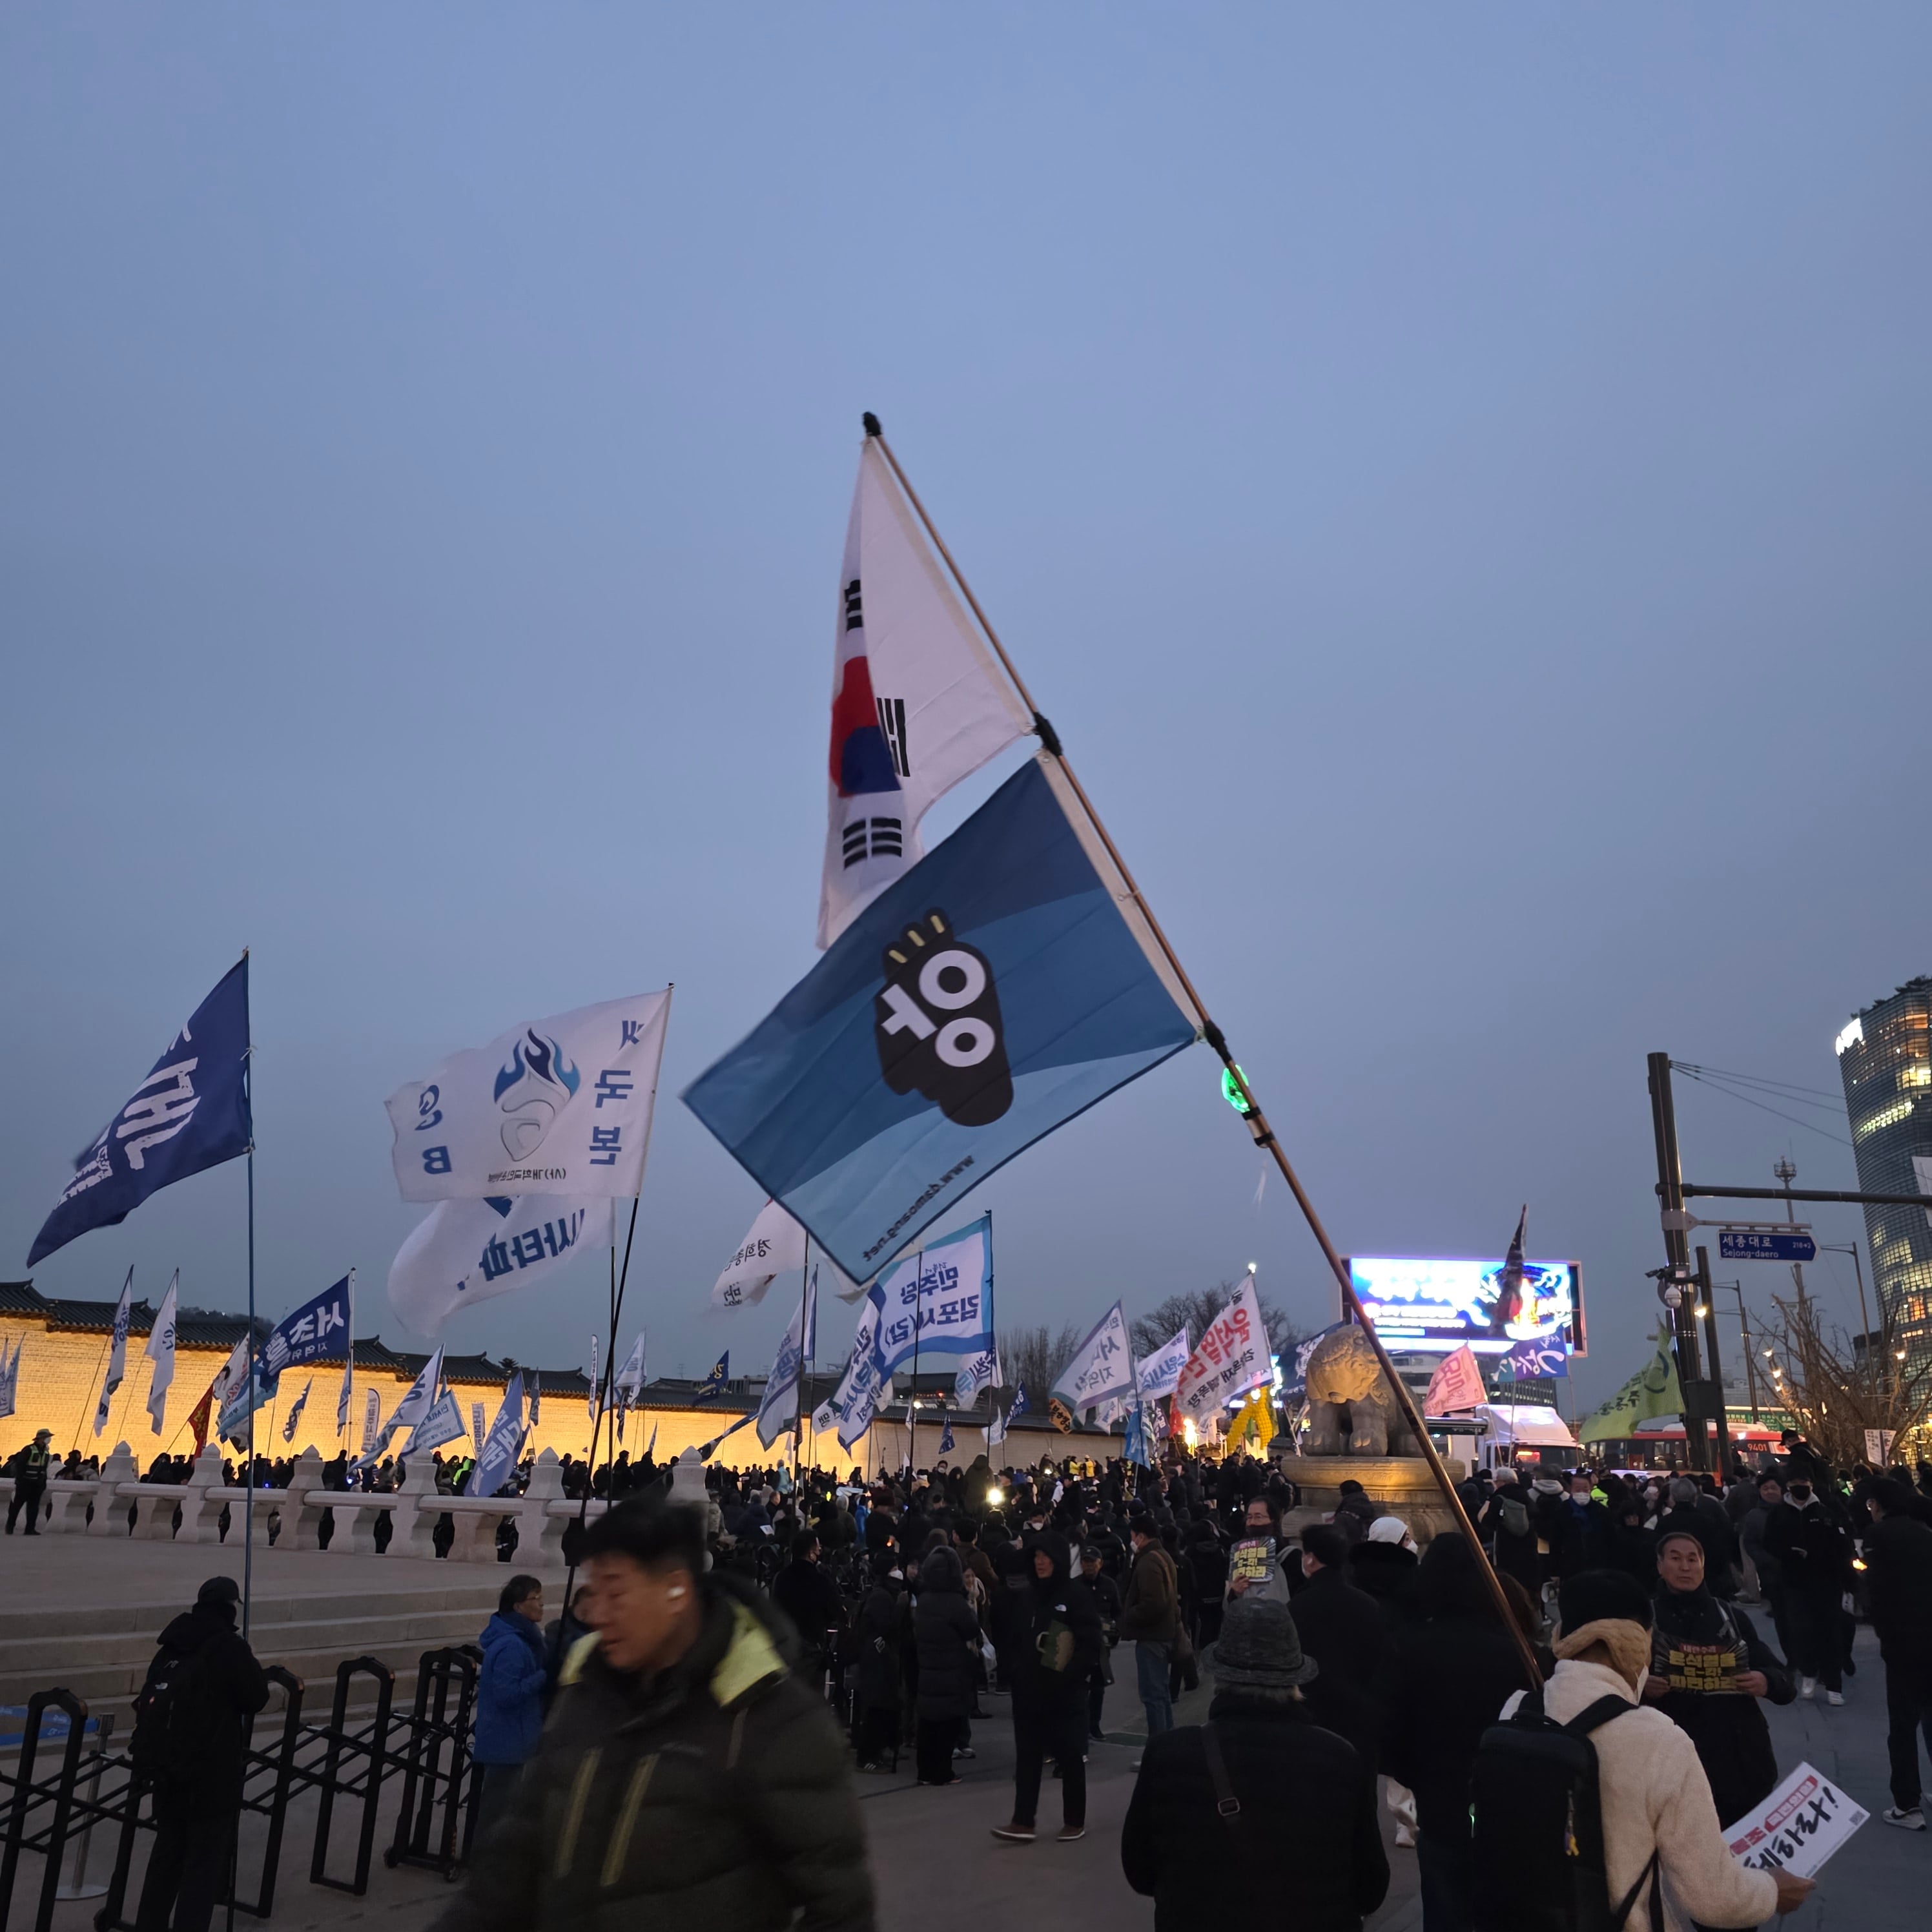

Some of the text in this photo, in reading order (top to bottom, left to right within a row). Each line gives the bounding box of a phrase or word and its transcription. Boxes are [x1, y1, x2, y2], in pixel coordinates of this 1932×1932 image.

[1722, 1234, 1773, 1248] 세종대로
[1722, 1248, 1779, 1259] Sejong-daero
[1747, 1443, 1768, 1452] 9401
